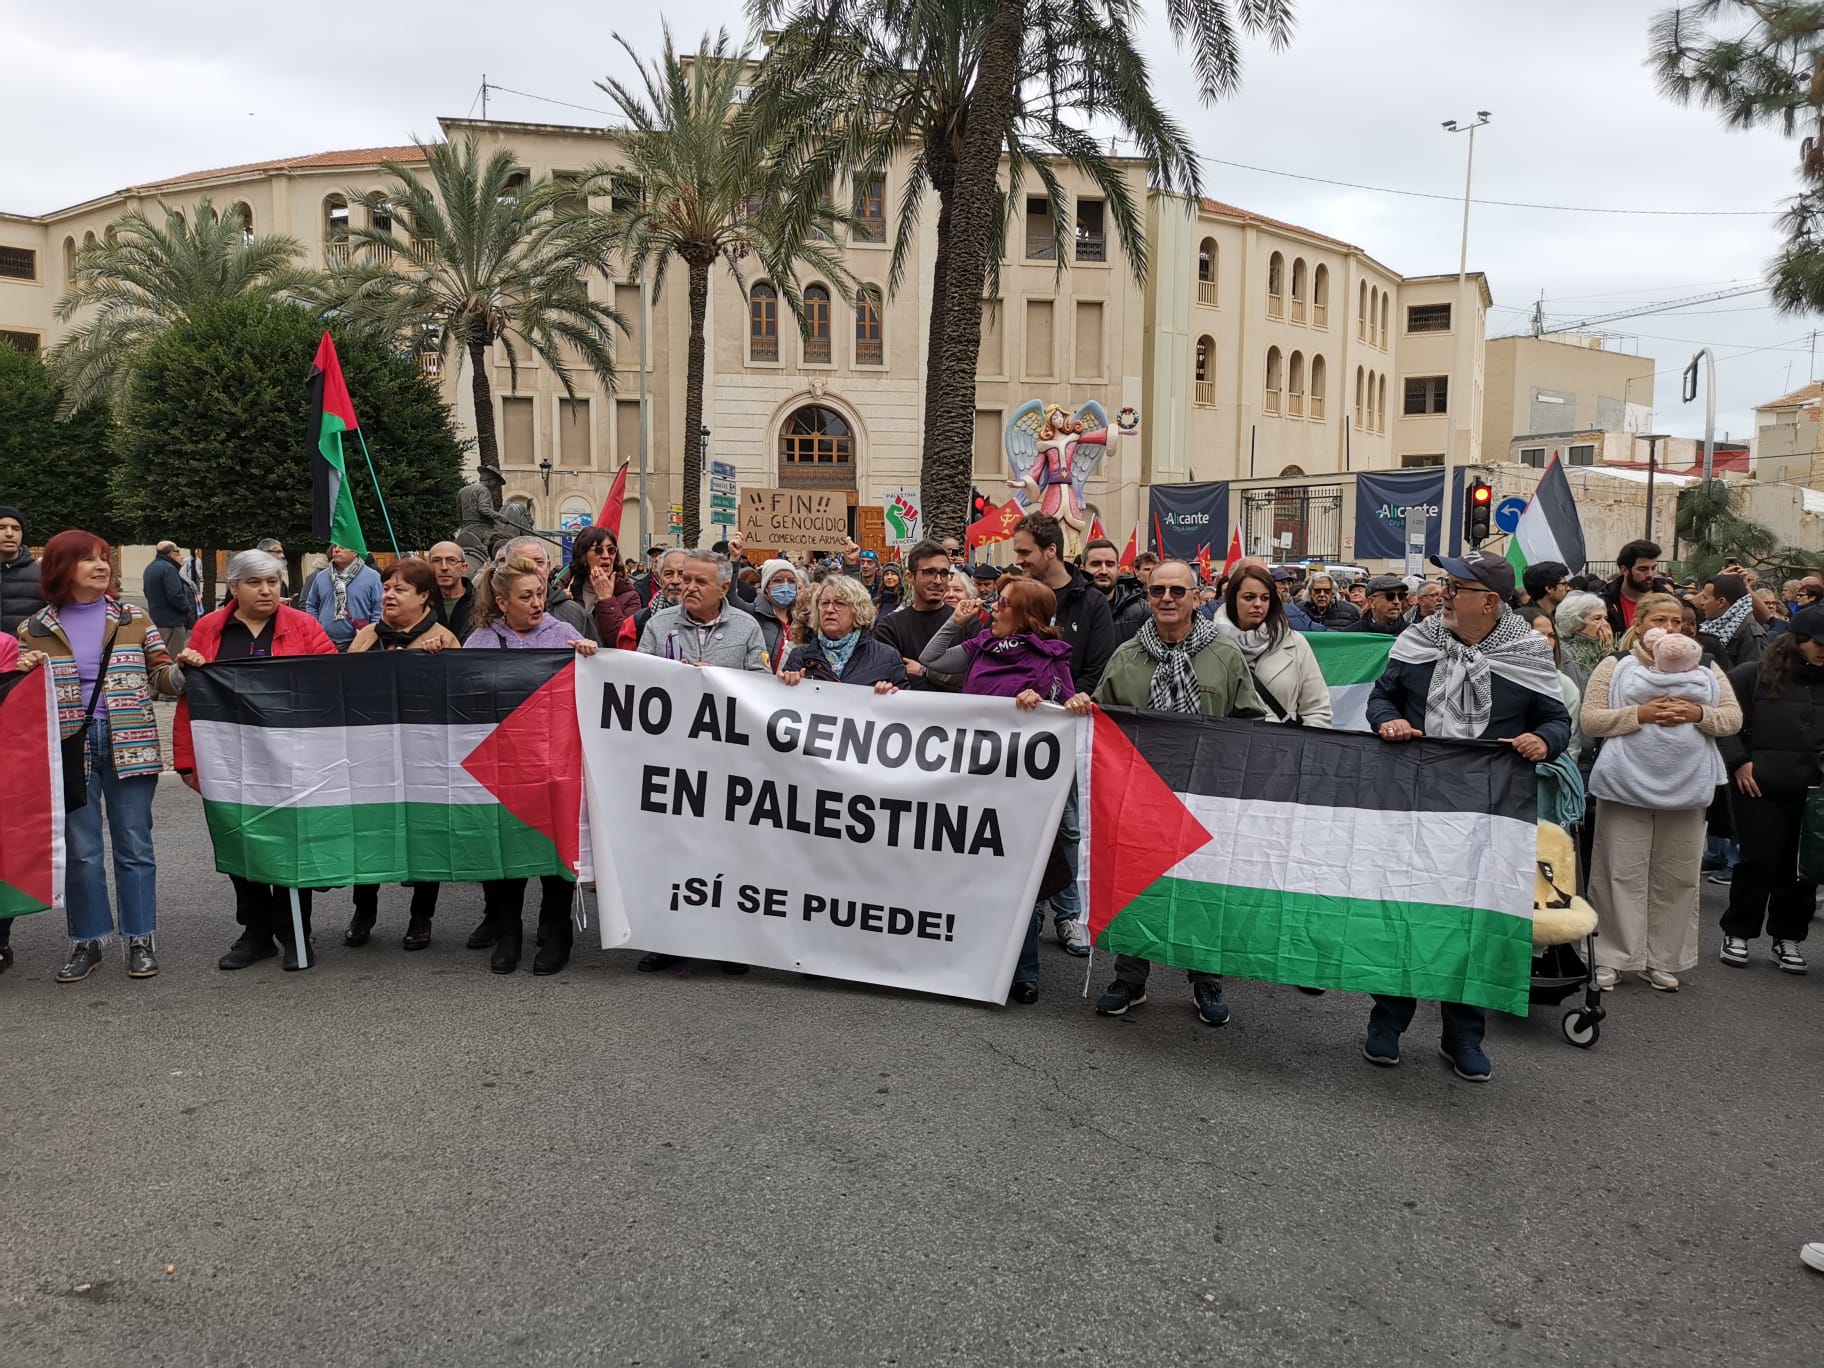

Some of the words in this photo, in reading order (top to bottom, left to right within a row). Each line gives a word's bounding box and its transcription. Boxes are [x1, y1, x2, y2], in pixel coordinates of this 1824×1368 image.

[745, 531, 763, 543] AL
[769, 533, 807, 545] COMERCIO
[819, 535, 848, 546] ARMAS
[747, 515, 764, 527] AL
[770, 514, 846, 532] GENOCIDIO
[1163, 511, 1210, 525] Alicante
[601, 682, 673, 736] NO
[688, 693, 750, 747] AL
[767, 708, 1061, 781] GENOCIDIO
[641, 765, 708, 818] EN
[725, 775, 1005, 857] PALESTINA
[669, 873, 724, 911] ¡SÍ
[737, 884, 789, 918] SE
[803, 893, 957, 943] PUEDE!
